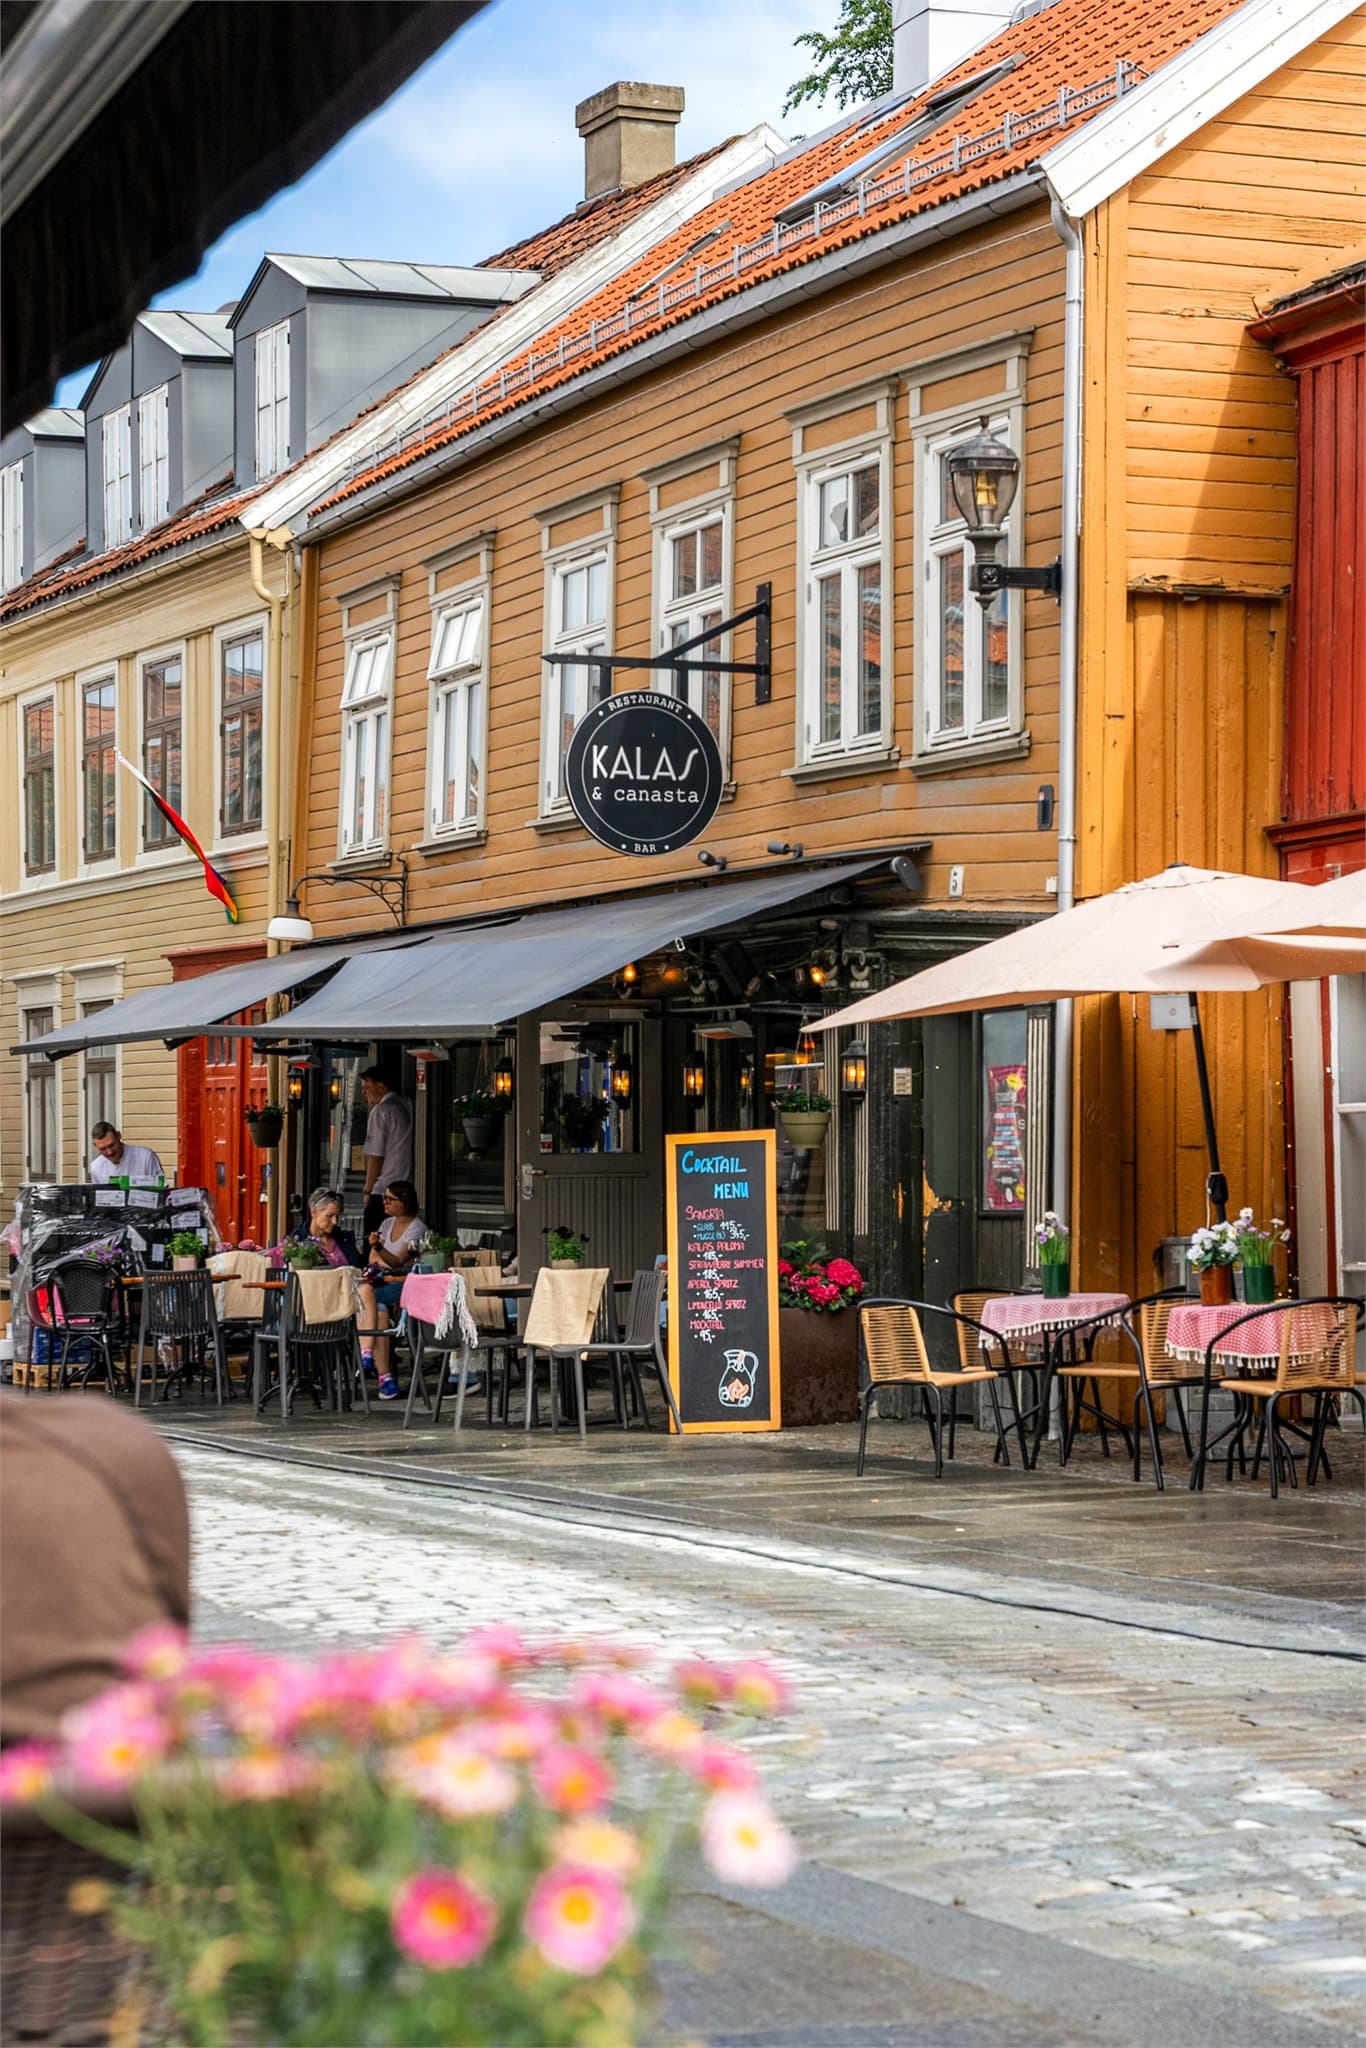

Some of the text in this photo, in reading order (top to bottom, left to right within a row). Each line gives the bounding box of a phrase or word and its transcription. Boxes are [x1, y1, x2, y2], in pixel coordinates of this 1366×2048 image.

[608, 694, 682, 713] RESTAURANT
[592, 744, 699, 781] KALAS
[592, 786, 699, 803] & canasta
[634, 843, 657, 853] BAR
[714, 1181, 749, 1199] MENU
[685, 1205, 725, 1220] SANGRIA
[687, 1241, 745, 1252] KALAS PALOMA
[733, 1258, 765, 1269] SUMMER
[687, 1279, 739, 1289] APEROL SPRITZ
